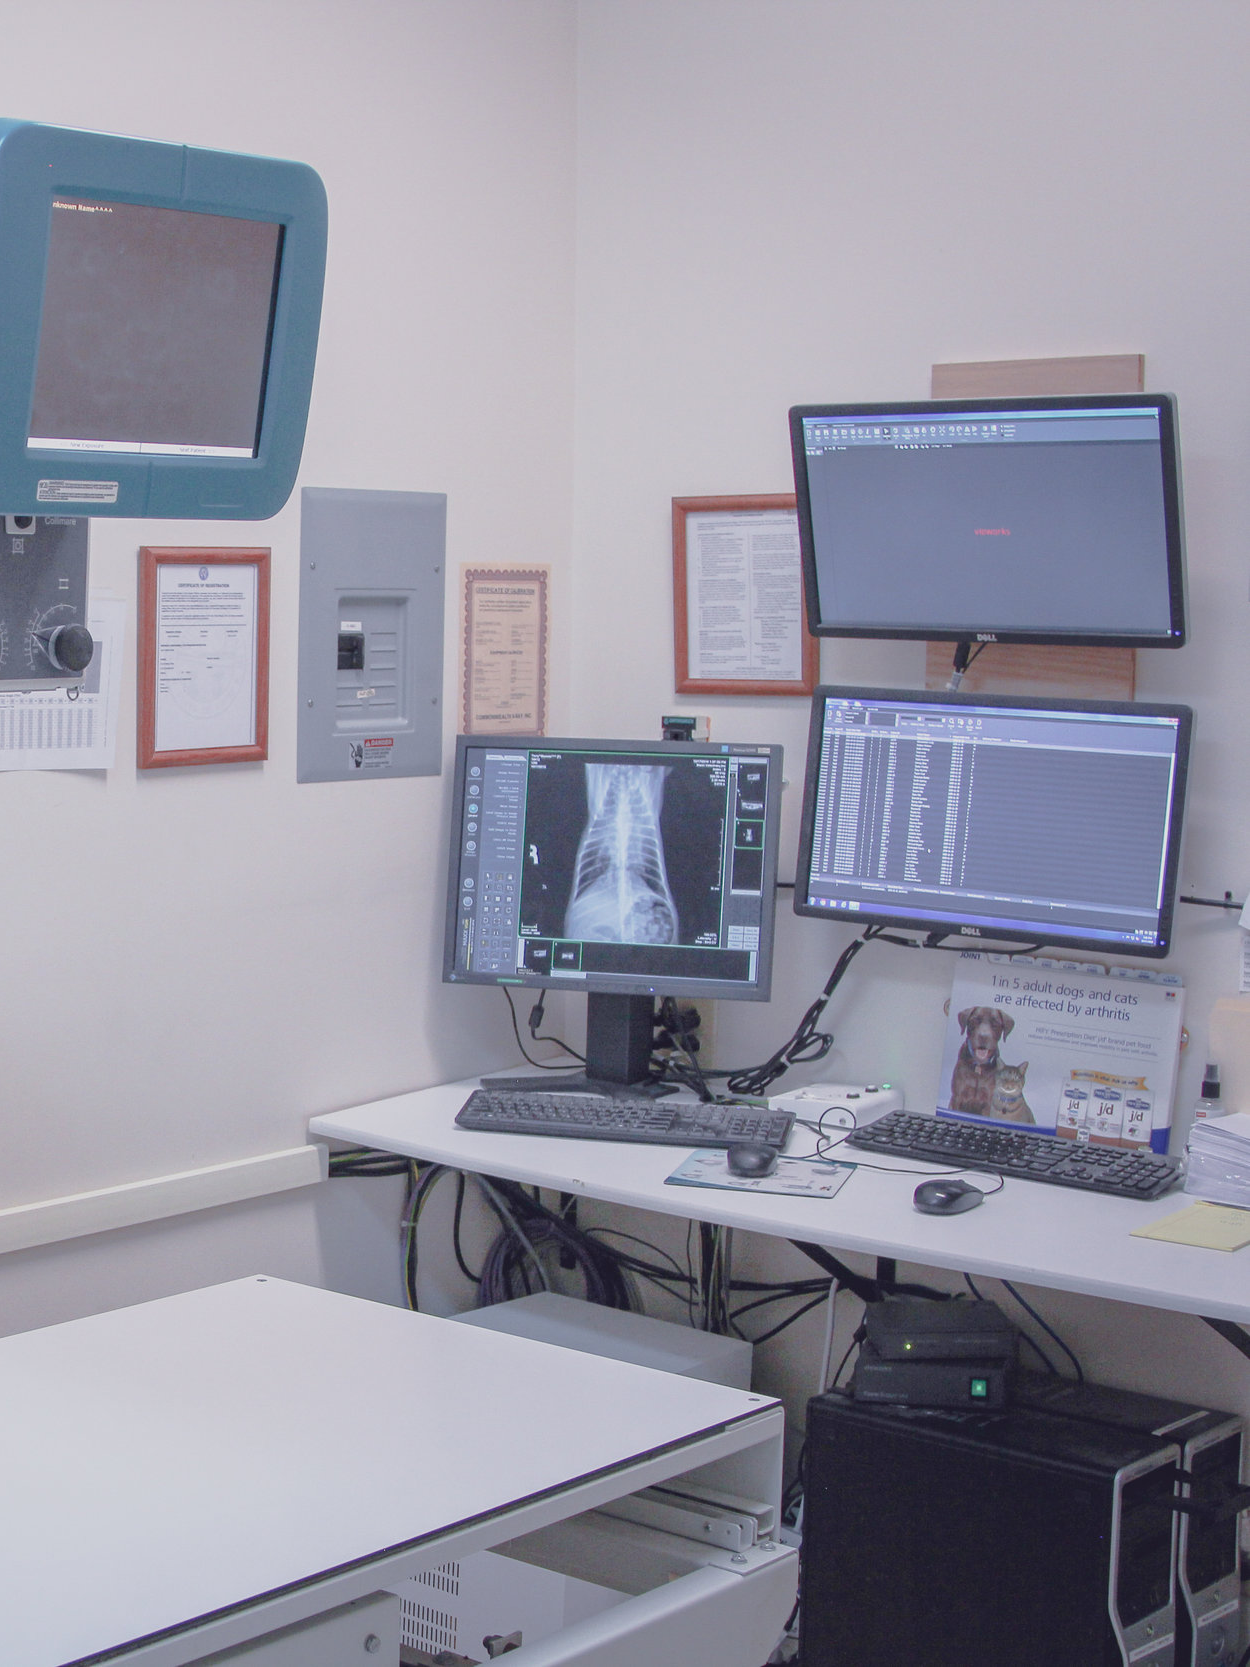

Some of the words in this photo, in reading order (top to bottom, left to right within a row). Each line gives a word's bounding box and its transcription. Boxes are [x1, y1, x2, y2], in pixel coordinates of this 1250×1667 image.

[52, 201, 77, 210] nknown
[976, 633, 998, 642] DELL
[961, 926, 981, 936] DELL
[960, 951, 981, 961] JOINT
[992, 975, 997, 987] 1
[998, 976, 1009, 988] in
[1013, 978, 1020, 989] 5
[1023, 980, 1052, 994] adult
[1056, 984, 1084, 1000] dogs
[1088, 989, 1111, 1002] and
[1114, 993, 1138, 1006] cats
[994, 993, 1012, 1005] are
[1015, 995, 1064, 1012] affected
[1067, 1001, 1082, 1017] by
[1085, 1006, 1130, 1021] arthritis
[1067, 1100, 1080, 1110] j/d
[1096, 1102, 1114, 1117] j/d
[1128, 1110, 1144, 1123] j/d
